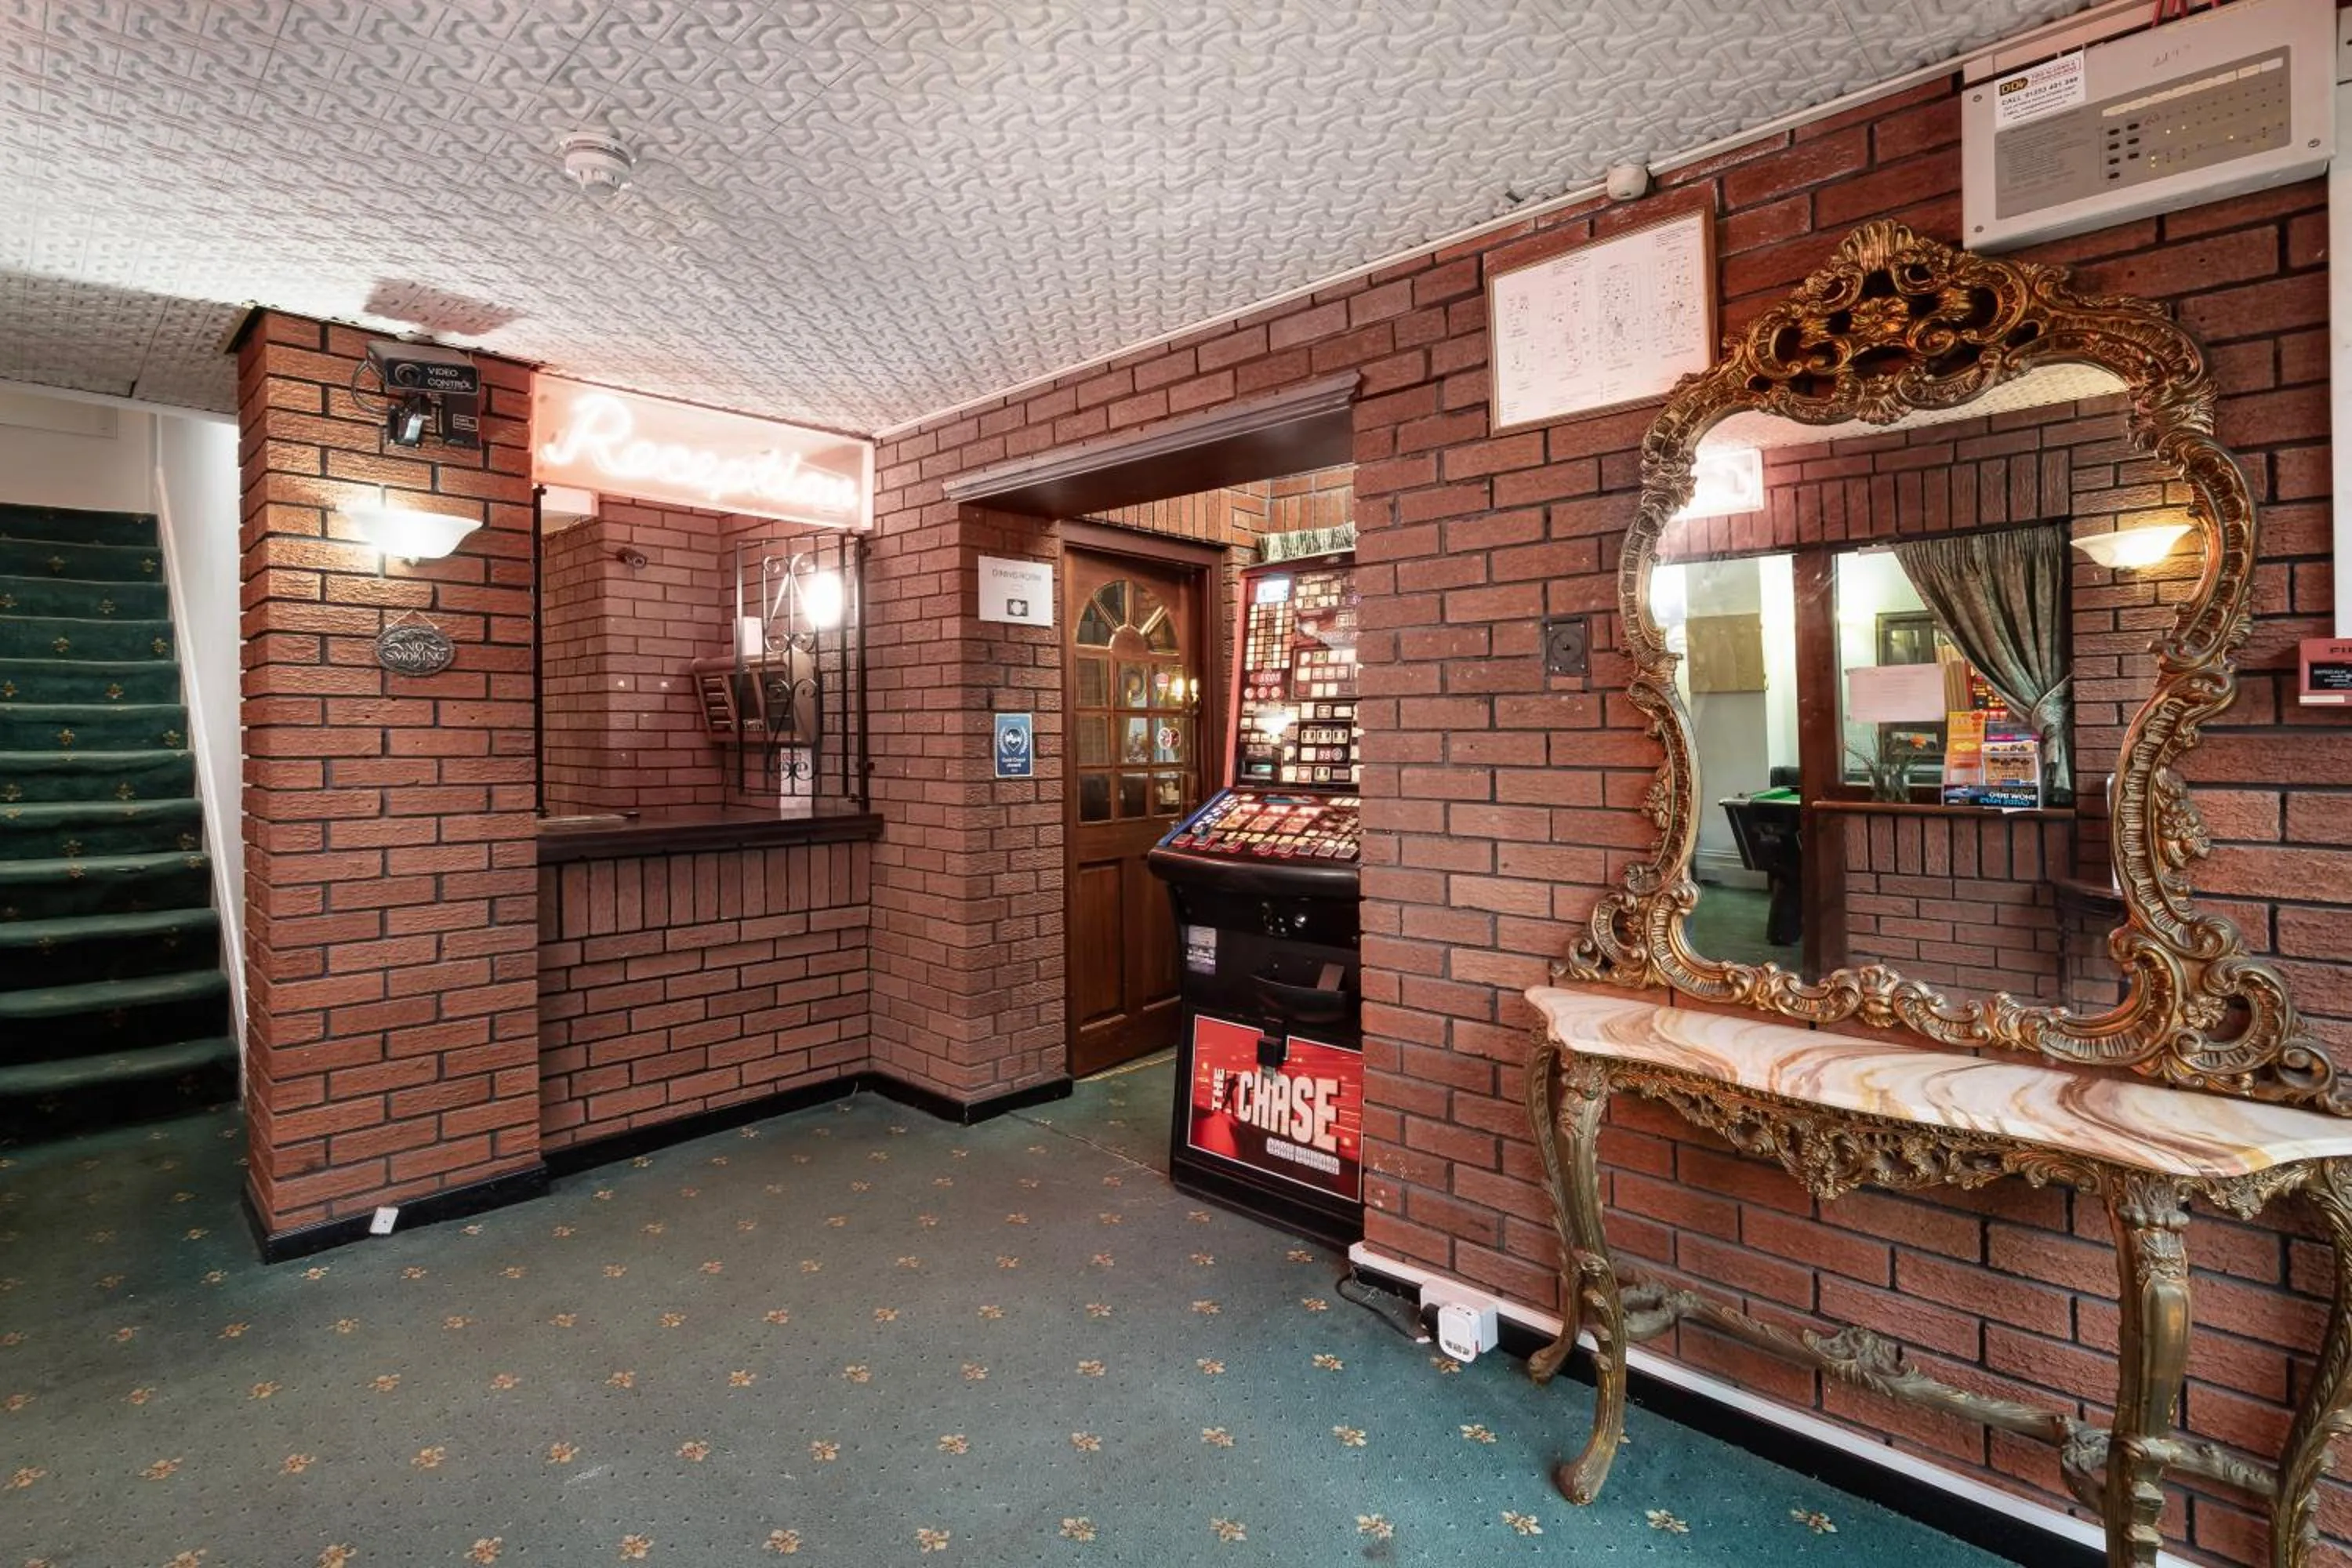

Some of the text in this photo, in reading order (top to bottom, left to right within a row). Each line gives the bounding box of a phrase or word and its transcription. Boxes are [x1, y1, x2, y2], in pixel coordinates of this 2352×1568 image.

[427, 366, 459, 377] VIDEO
[427, 378, 473, 390] CONTROL
[541, 394, 859, 509] Reception
[406, 641, 424, 652] NO
[385, 651, 445, 664] SMOKING
[1212, 1068, 1225, 1110] THE
[1239, 1069, 1338, 1152] CHASE
